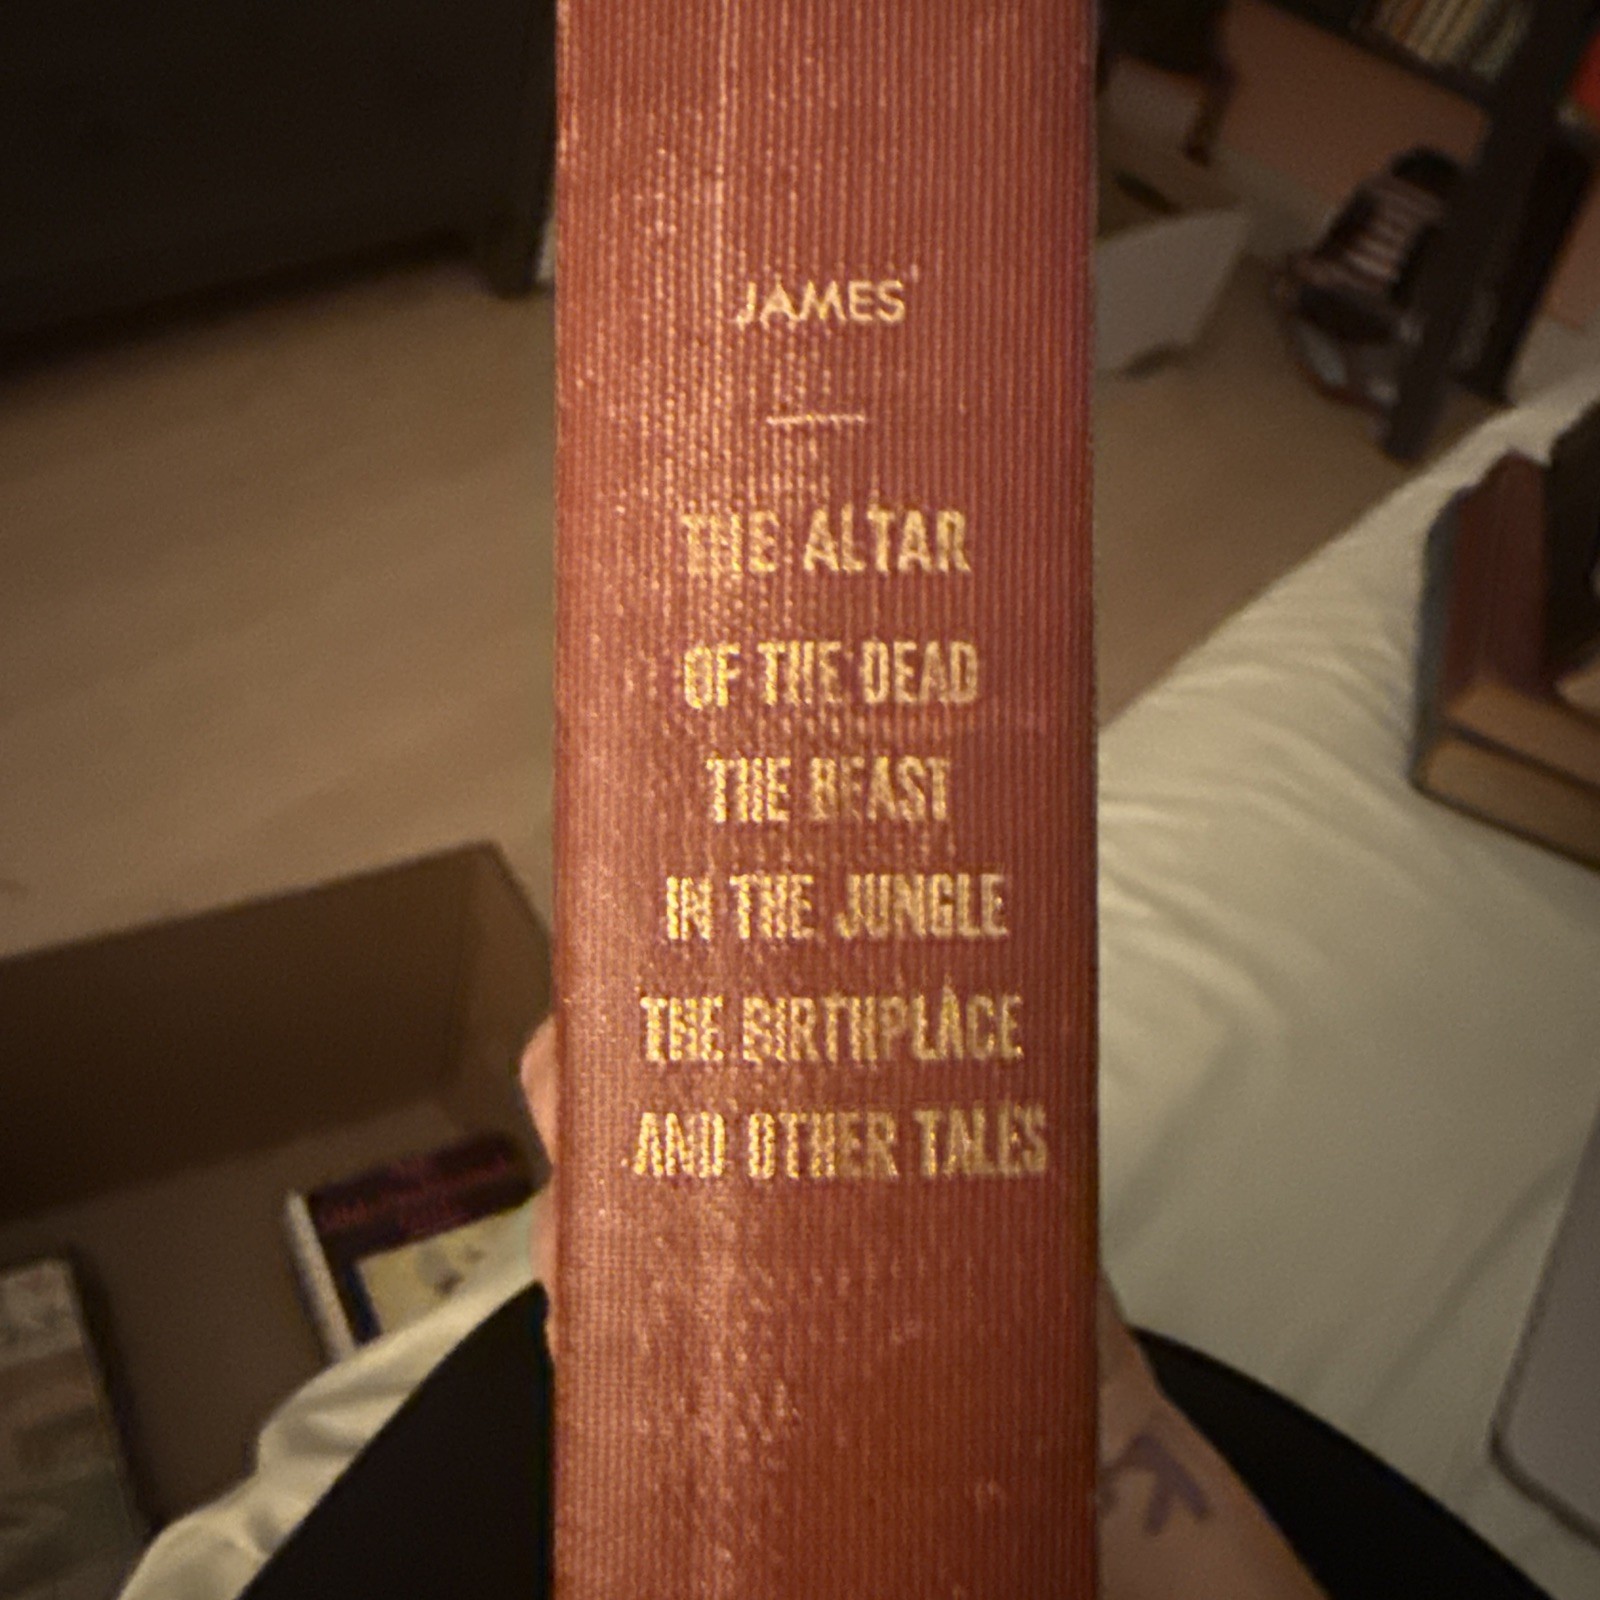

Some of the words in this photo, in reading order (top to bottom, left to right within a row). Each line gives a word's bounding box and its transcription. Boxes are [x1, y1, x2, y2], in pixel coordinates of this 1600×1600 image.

[736, 279, 905, 327] JAMES
[681, 509, 780, 574] THE
[804, 506, 971, 574] ALTAR
[683, 643, 740, 708] OF
[757, 640, 844, 706] THE
[862, 640, 979, 706] DEAD
[706, 756, 791, 823] THE
[810, 756, 951, 822] BEAST
[666, 876, 713, 940] IN
[730, 874, 815, 939] THE
[836, 873, 1008, 939] JUNGLE
[640, 996, 724, 1062] THE
[742, 993, 1024, 1063] BIRTHPLACE
[634, 1112, 726, 1177] AND
[748, 1112, 900, 1179] OTHER
[913, 1108, 1048, 1178] TALES
